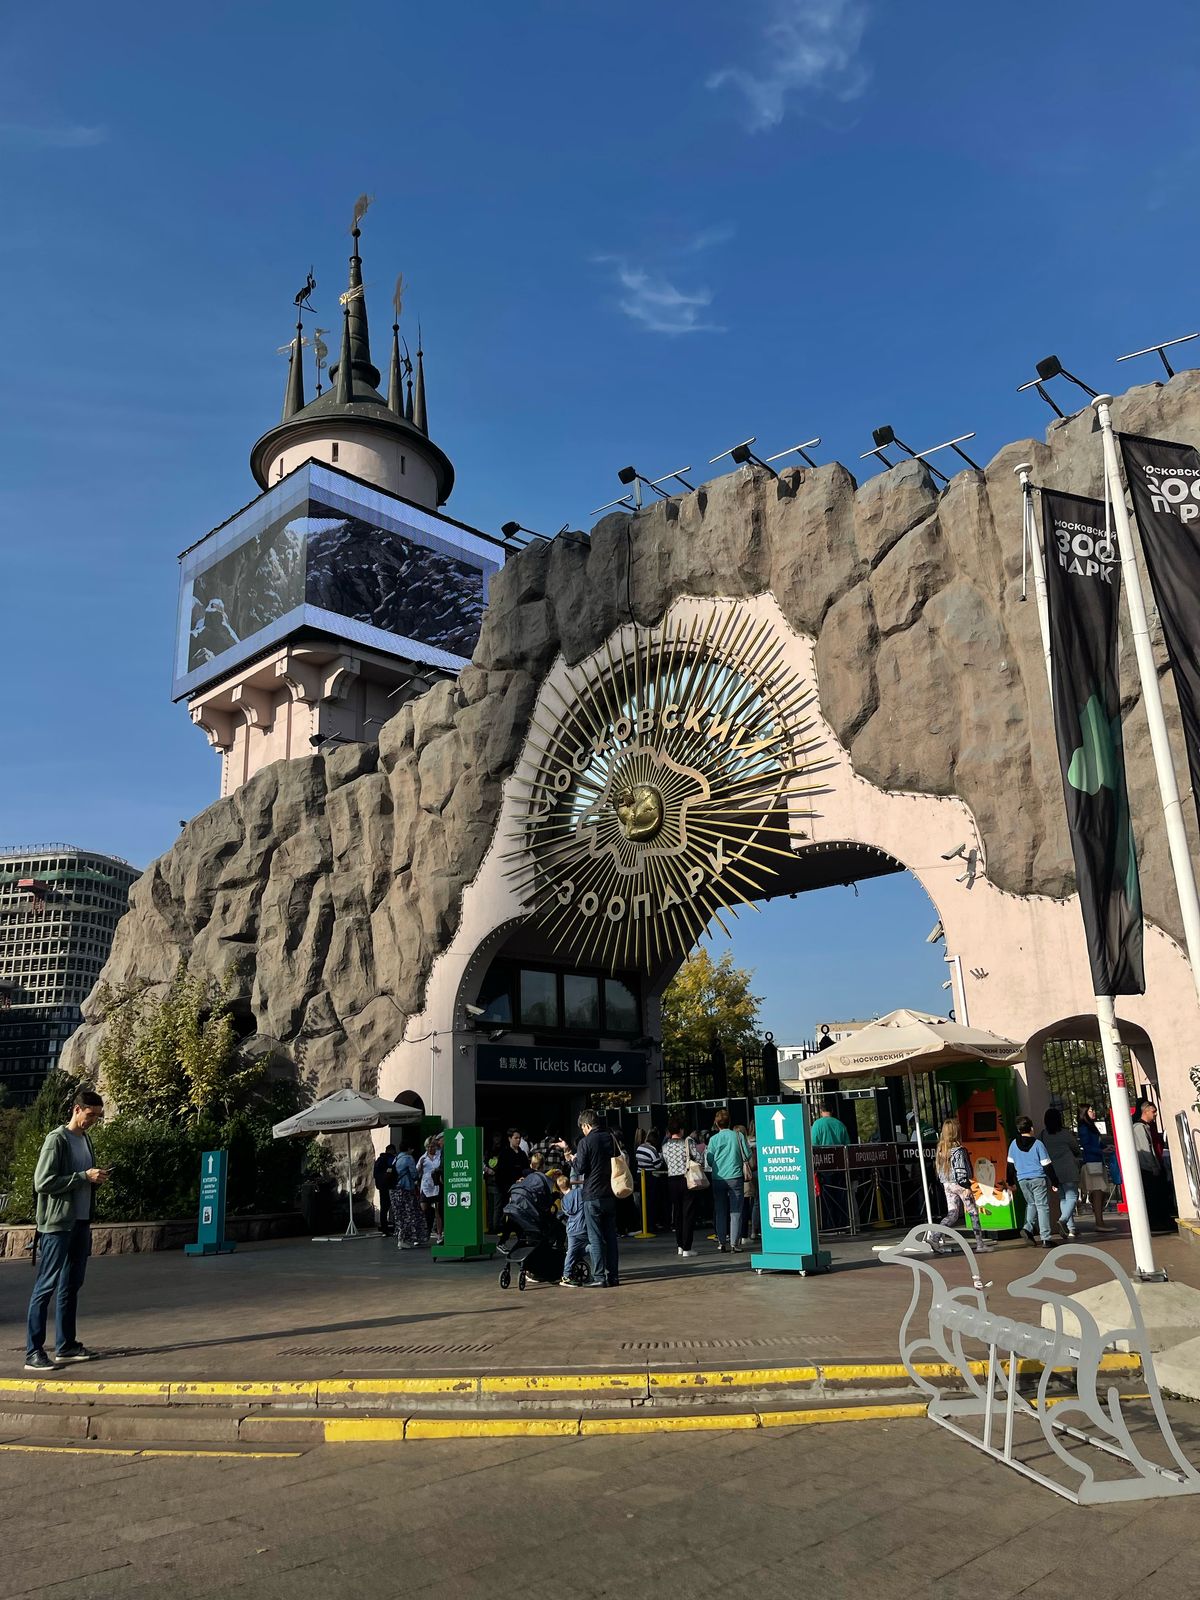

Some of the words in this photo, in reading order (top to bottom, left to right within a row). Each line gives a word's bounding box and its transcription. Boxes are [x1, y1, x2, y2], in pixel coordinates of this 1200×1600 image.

[1143, 465, 1200, 476] ОСКОВСК
[1151, 495, 1199, 523] ПР
[1055, 529, 1115, 563] ЗОО
[518, 703, 784, 824] МОСКОВСКИЙ
[556, 838, 733, 921] ЗООПАРК
[499, 1057, 527, 1070] 售票处
[534, 1057, 569, 1072] Tickets
[574, 1059, 606, 1073] Кассы
[762, 1146, 800, 1154] КУПИТЬ
[855, 1152, 878, 1162] ПРОХОДА
[879, 1150, 888, 1160] НЕТ
[451, 1160, 469, 1170] ВХОД
[824, 1153, 834, 1164] НЕТ
